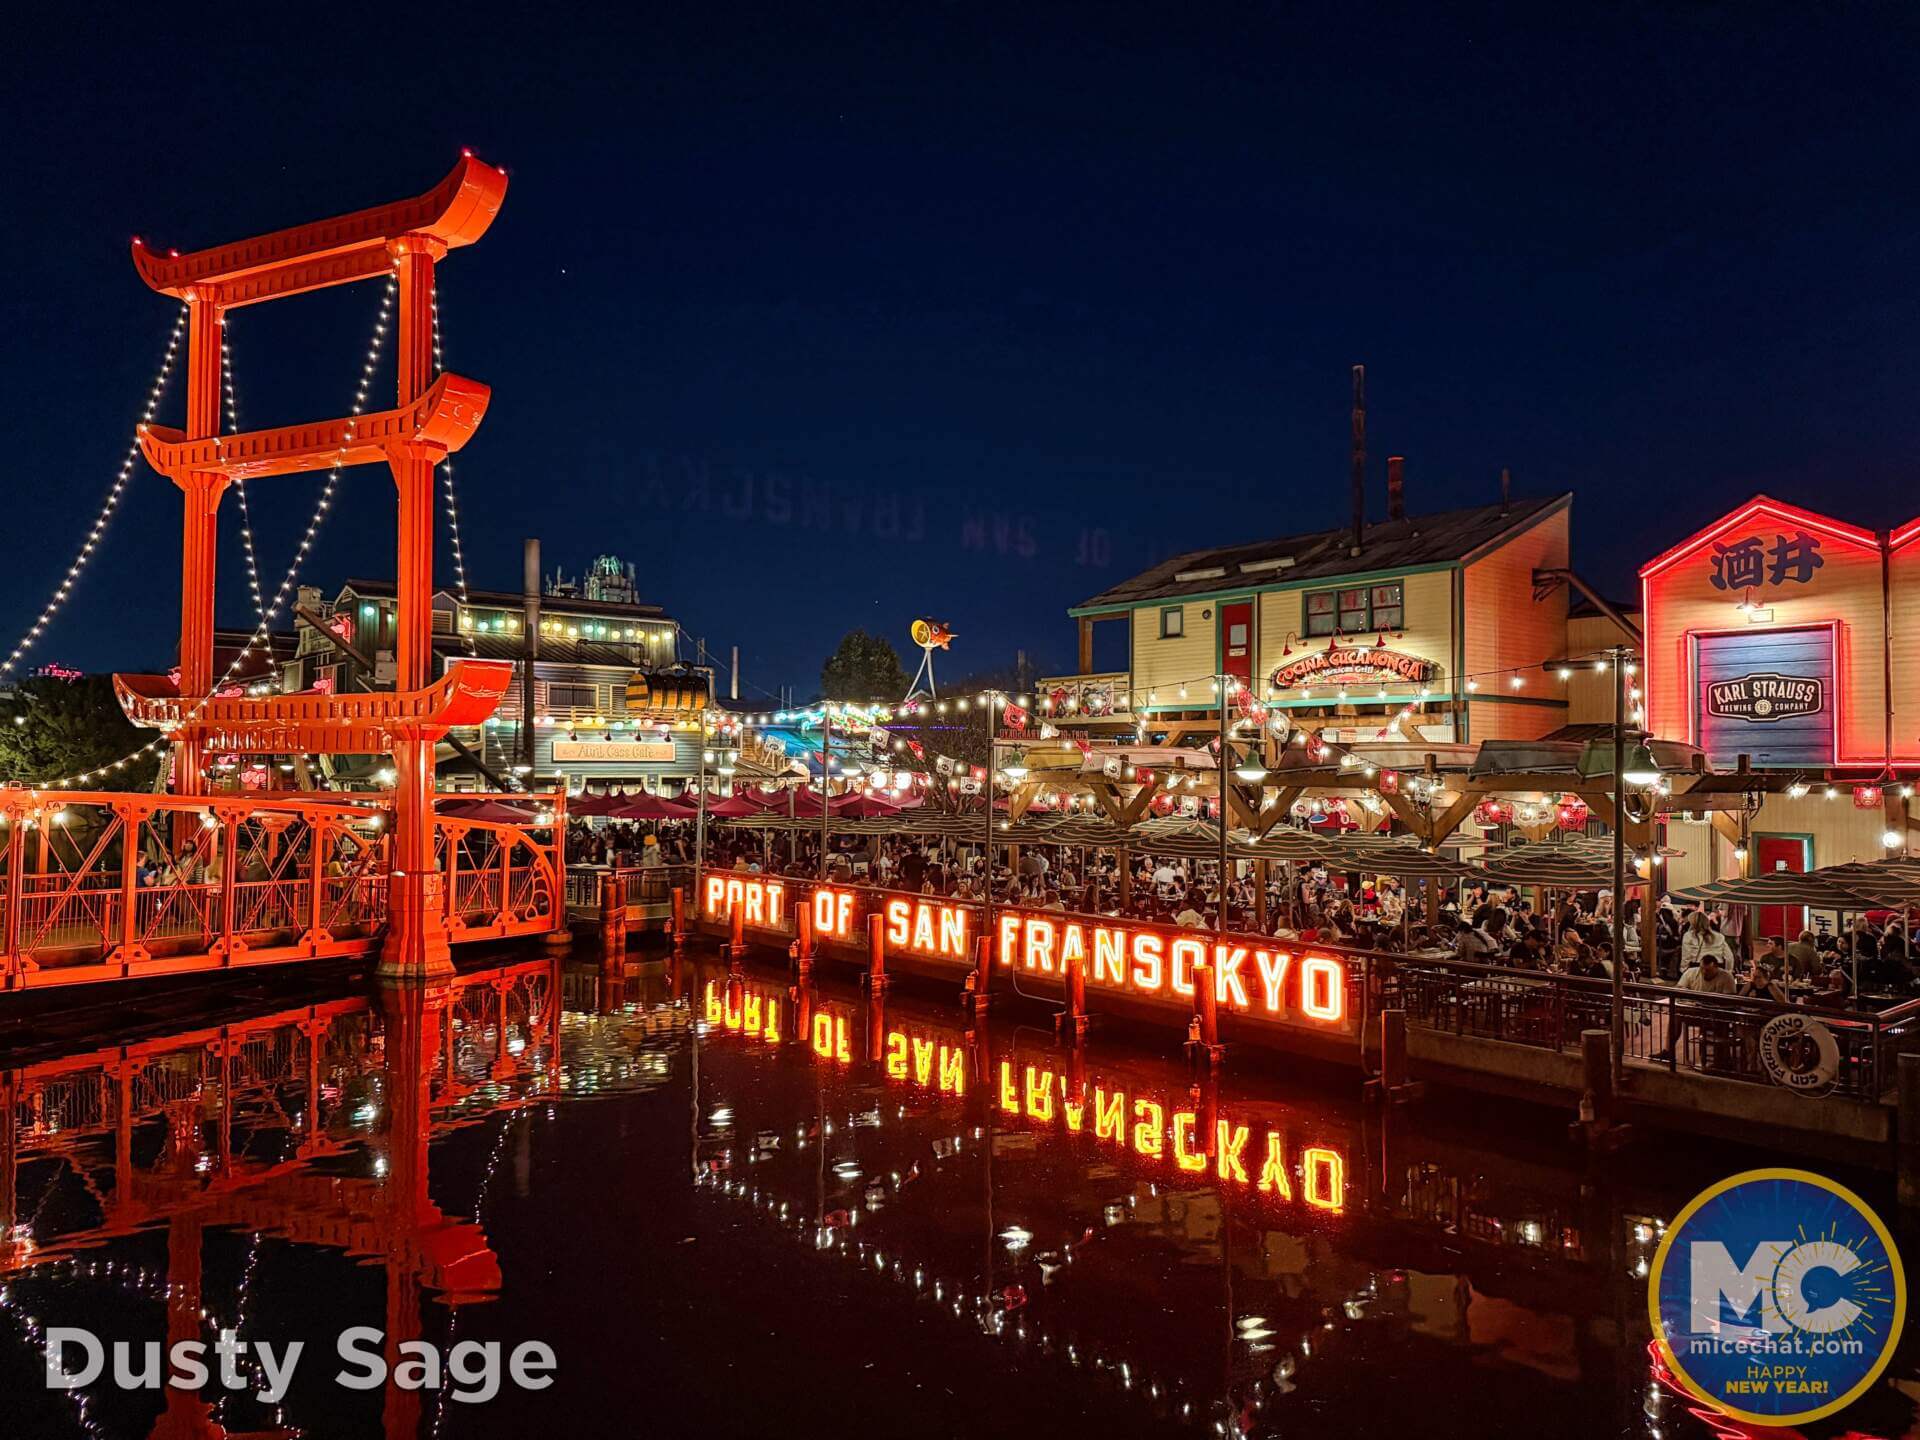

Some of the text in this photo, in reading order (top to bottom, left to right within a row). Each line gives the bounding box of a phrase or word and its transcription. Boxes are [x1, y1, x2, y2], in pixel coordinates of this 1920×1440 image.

[1710, 531, 1824, 590] 酒井
[1276, 650, 1421, 686] COCINA CUCAMONGA
[1322, 665, 1374, 677] Mexican Grill
[1714, 680, 1815, 705] KARL STRAUSS
[1719, 703, 1752, 712] BREWING
[1774, 702, 1809, 711] COMPANY
[708, 877, 1342, 1021] PORT OF SAN FRANSOKYO
